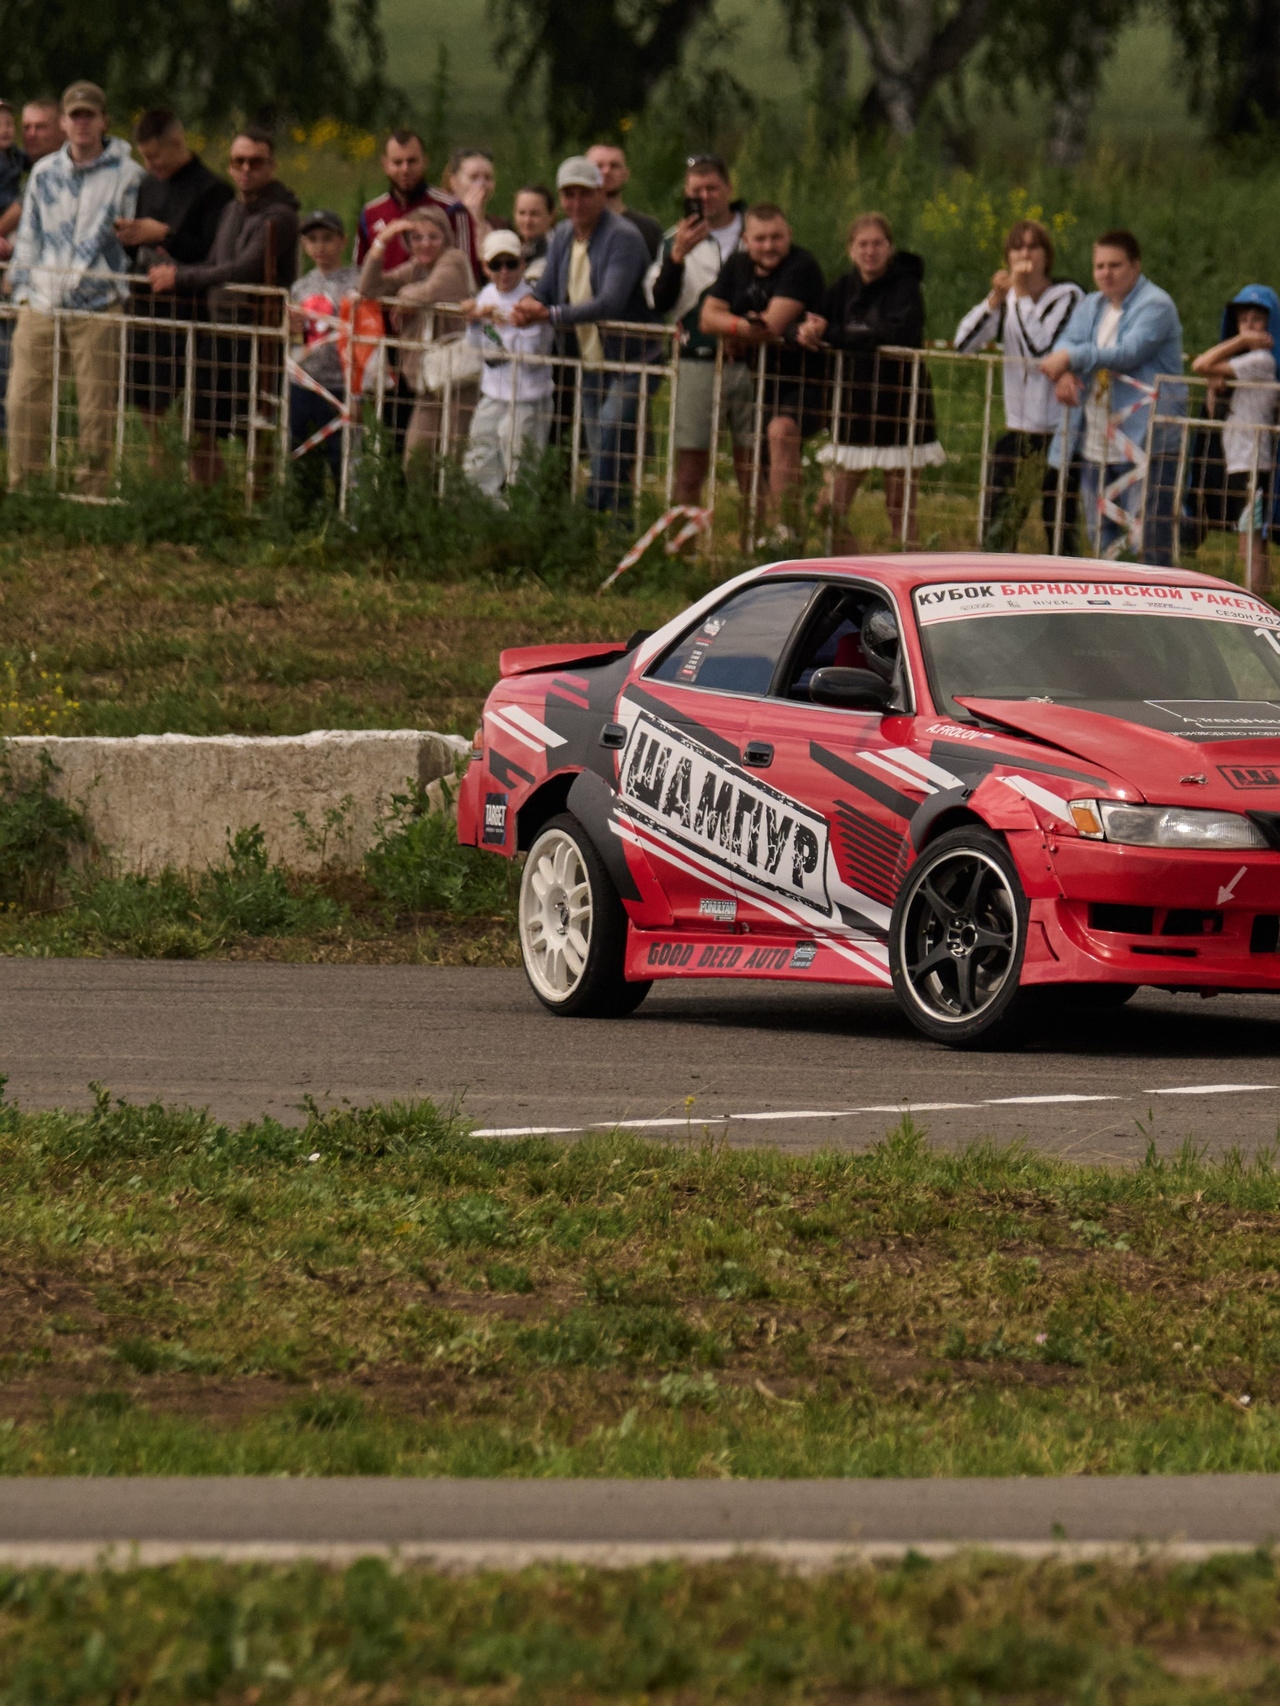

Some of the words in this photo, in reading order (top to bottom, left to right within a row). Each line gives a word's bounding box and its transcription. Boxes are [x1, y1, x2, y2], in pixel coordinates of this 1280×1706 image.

[918, 585, 995, 606] КУБОК
[1001, 583, 1184, 600] БАРНАУЛЬСКОЙ
[1215, 609, 1253, 621] СЕЗОН
[925, 723, 983, 740] A.FROLOV
[485, 804, 507, 826] TARGET
[625, 731, 818, 889] ШАМПУР
